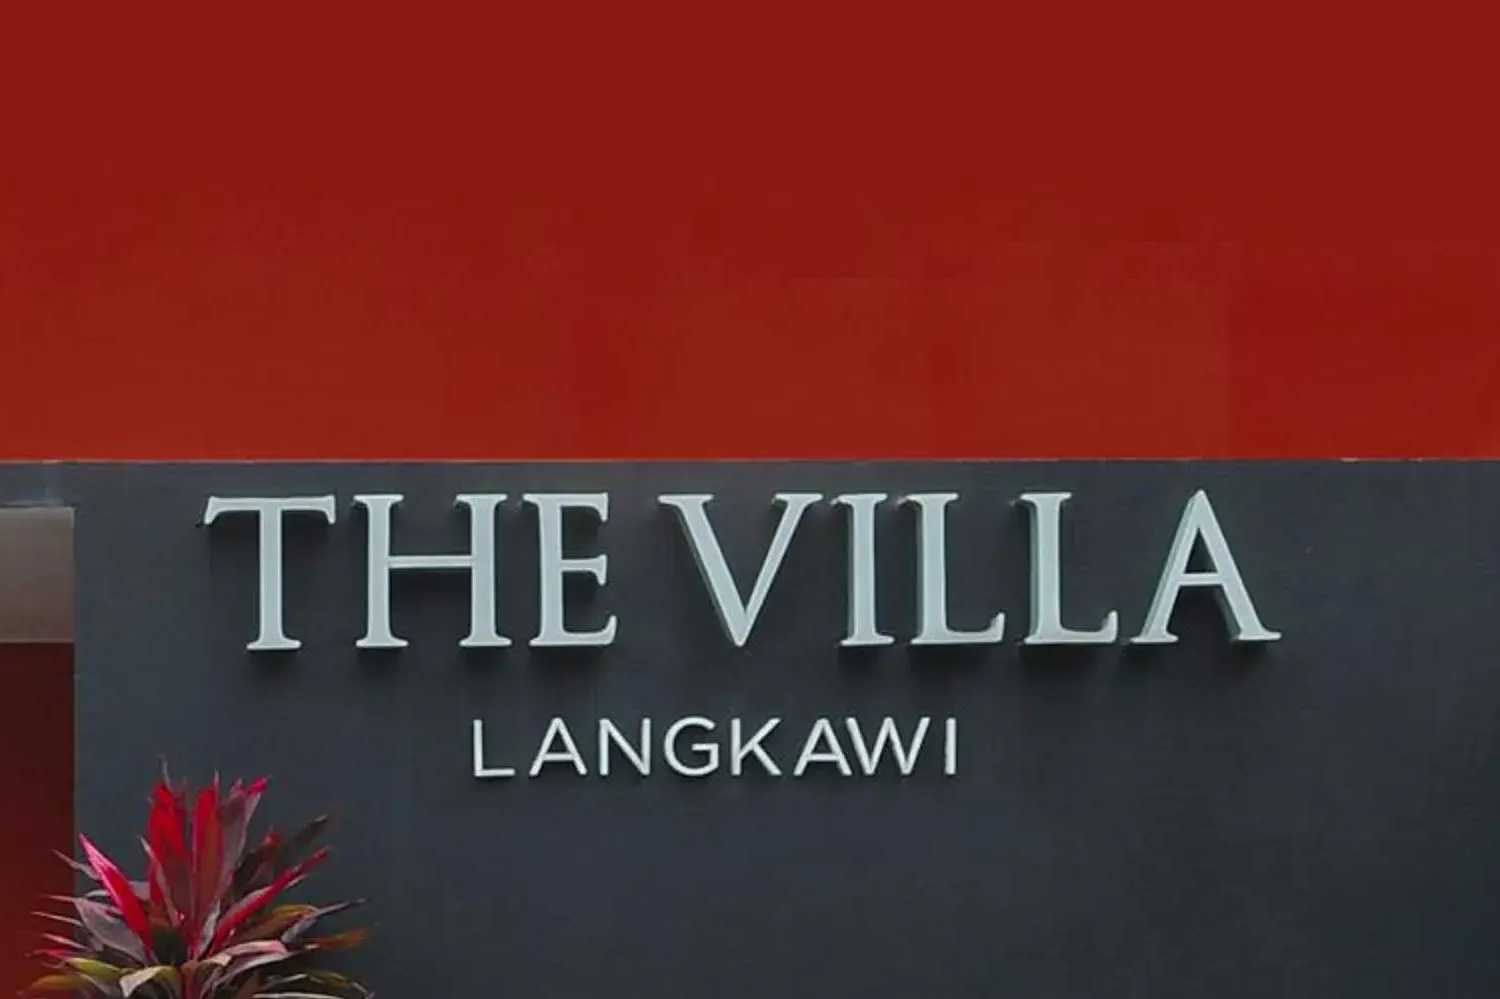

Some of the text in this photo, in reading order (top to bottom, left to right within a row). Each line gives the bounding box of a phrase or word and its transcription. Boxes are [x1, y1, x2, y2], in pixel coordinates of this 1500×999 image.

[203, 489, 1282, 651] THE VILLA
[472, 716, 958, 777] LANGKAWI
